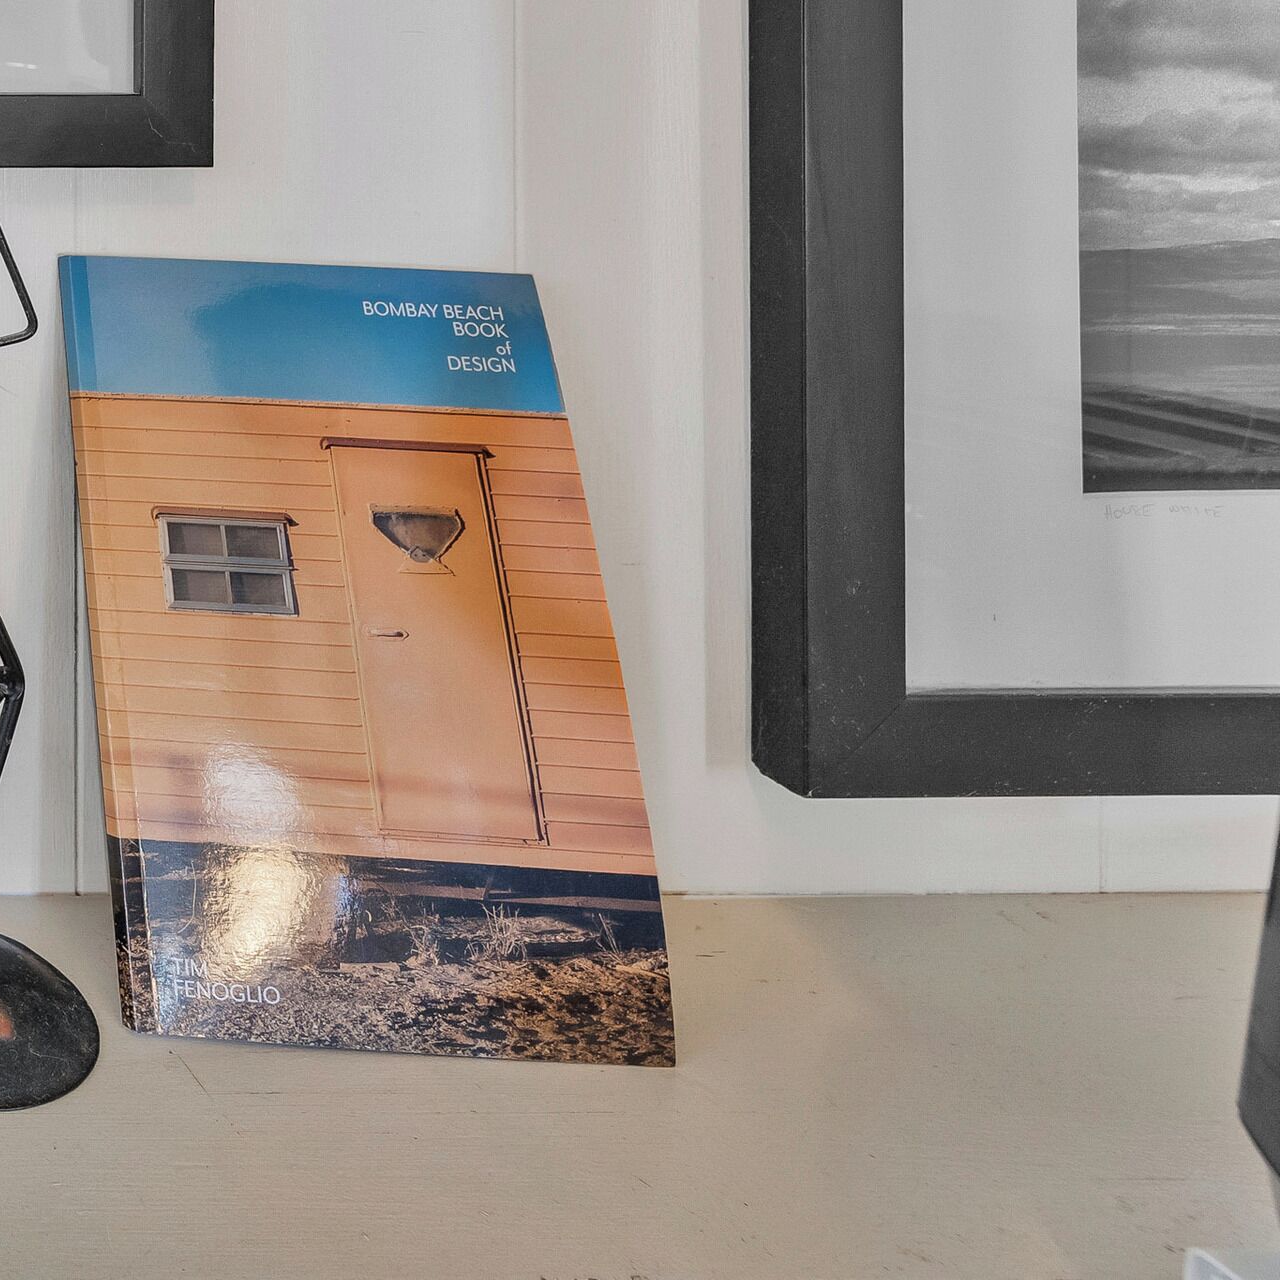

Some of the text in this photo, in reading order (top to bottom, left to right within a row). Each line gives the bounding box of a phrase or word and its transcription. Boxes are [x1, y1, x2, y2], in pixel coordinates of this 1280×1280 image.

[362, 301, 504, 321] BOMBAY BEACH
[452, 321, 509, 338] BOOK
[496, 341, 512, 356] of
[447, 355, 516, 373] DESIGN
[172, 957, 209, 980] TIM
[174, 979, 281, 1004] FENOGLIO
